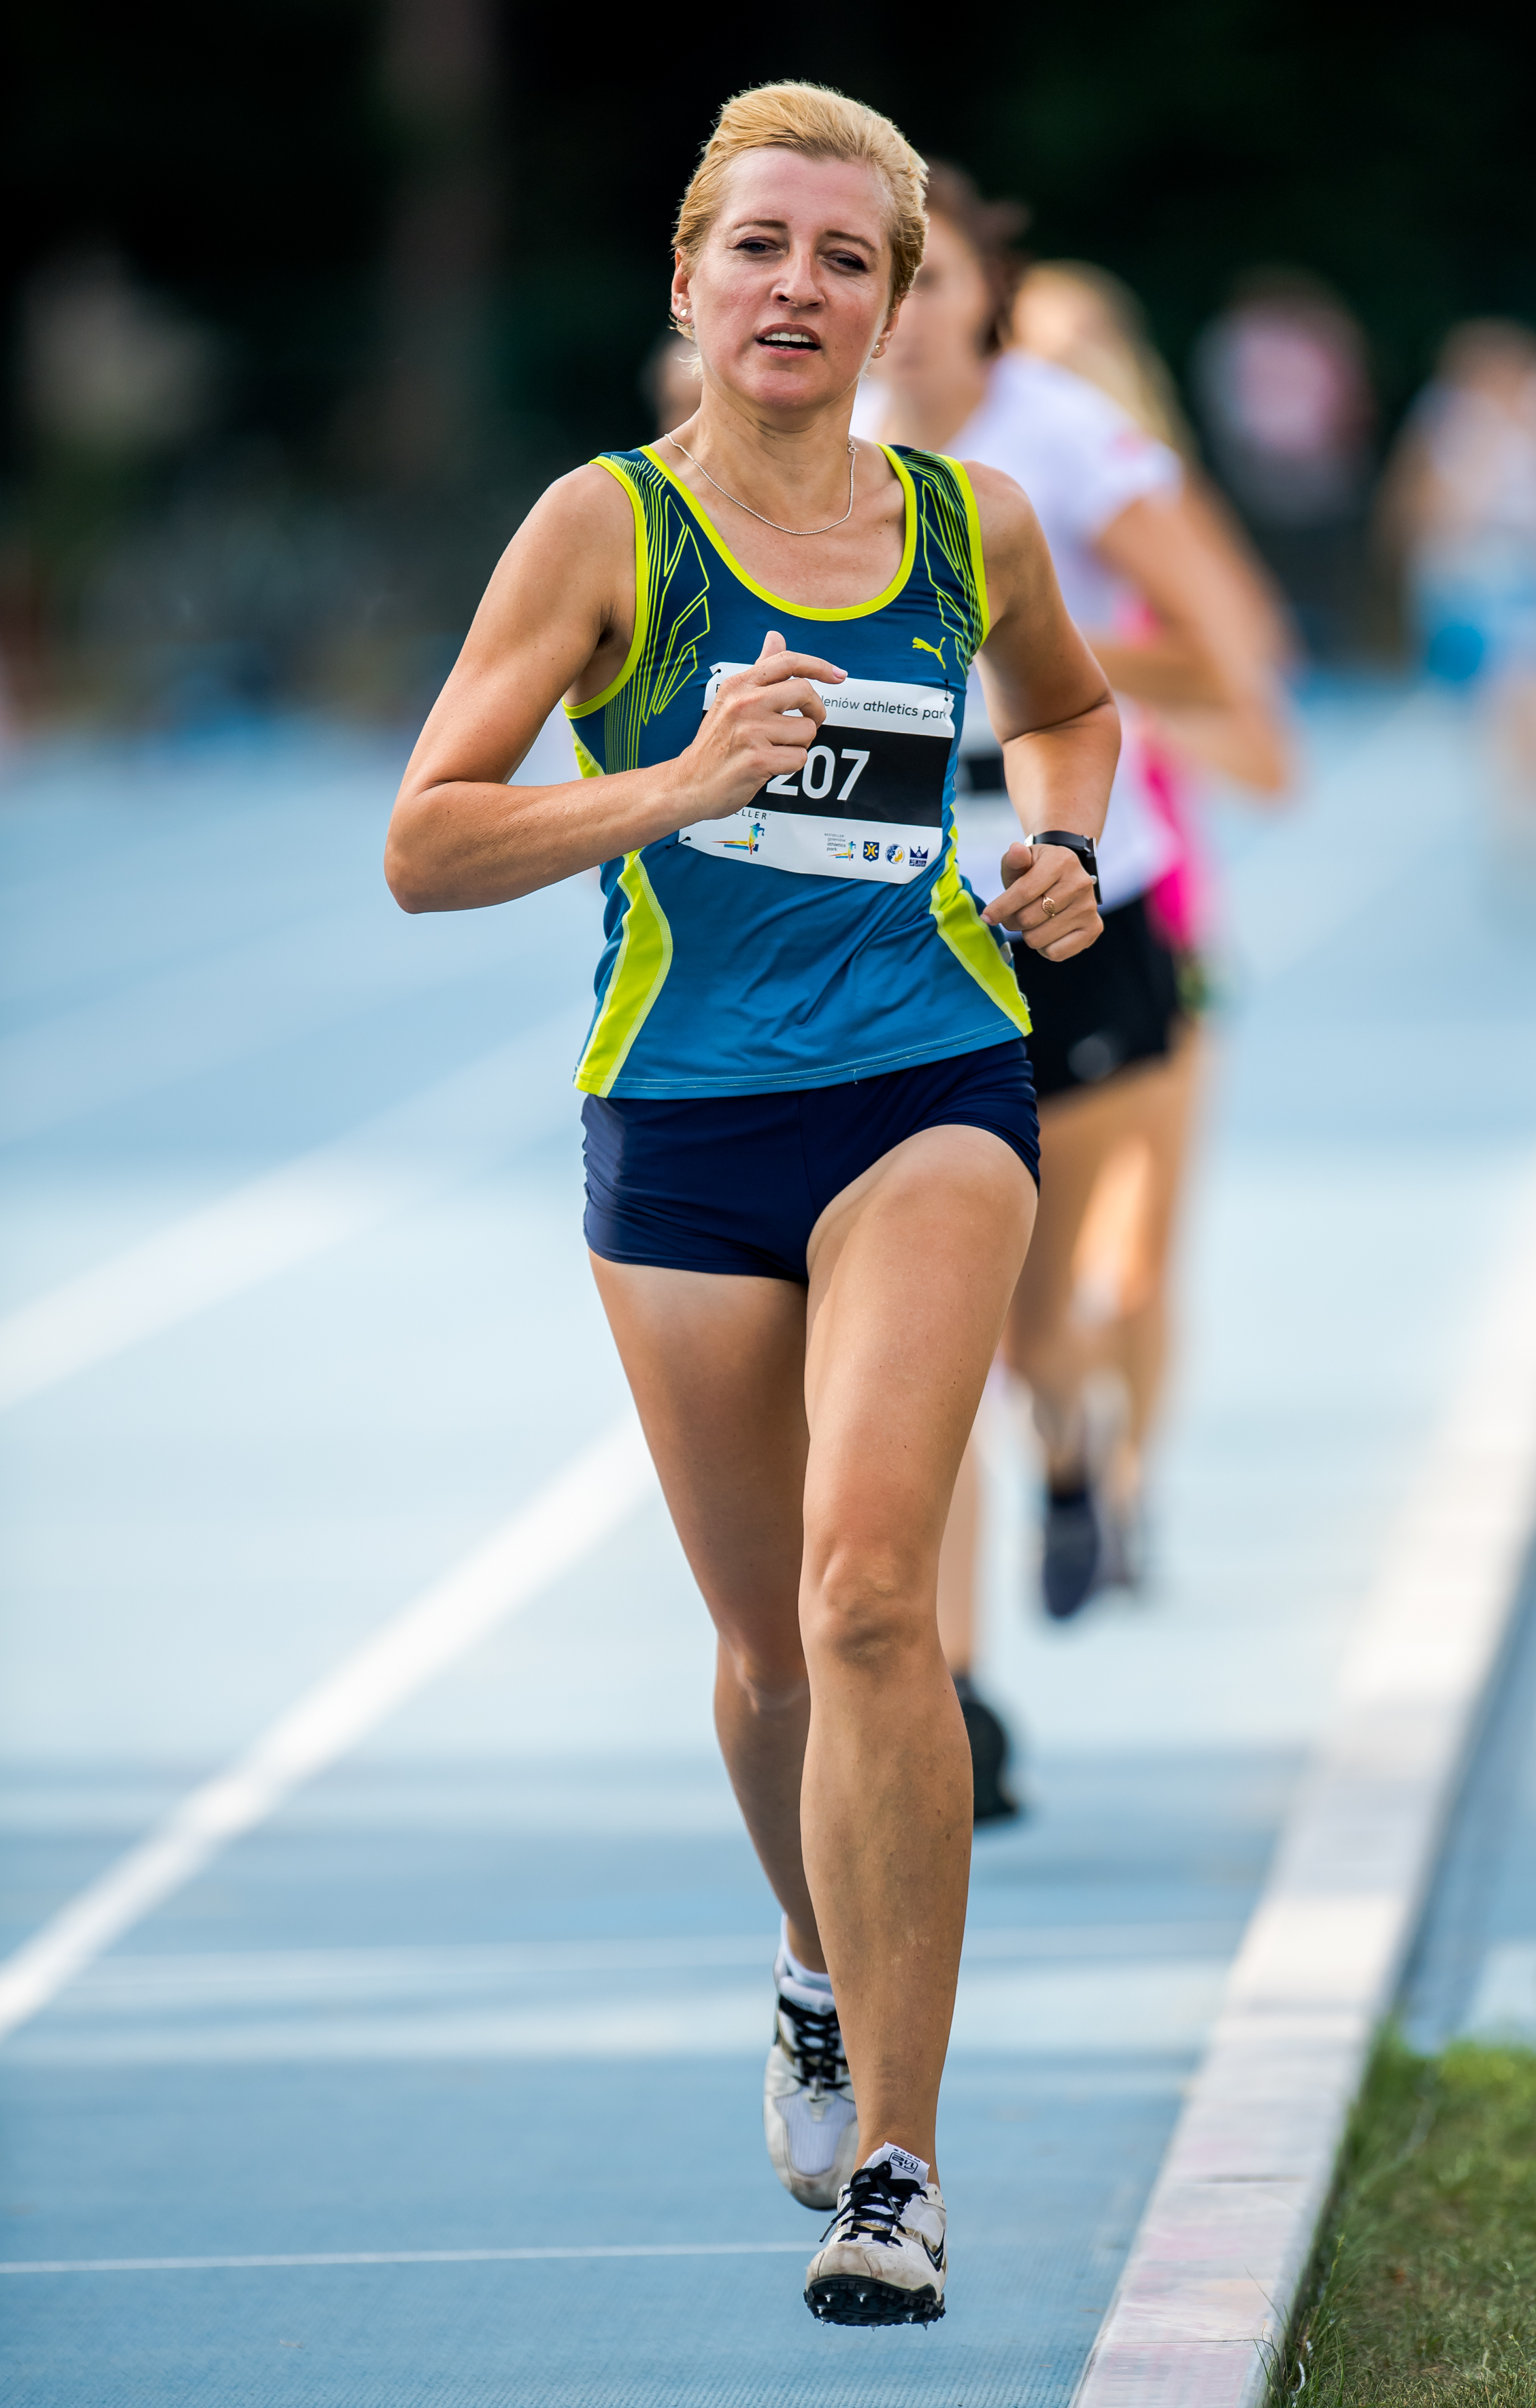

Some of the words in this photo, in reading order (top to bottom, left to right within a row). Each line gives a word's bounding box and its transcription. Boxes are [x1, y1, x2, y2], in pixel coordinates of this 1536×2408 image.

[821, 695, 860, 710] leniów
[863, 700, 918, 717] athletics
[893, 2148, 920, 2163] ZOOM
